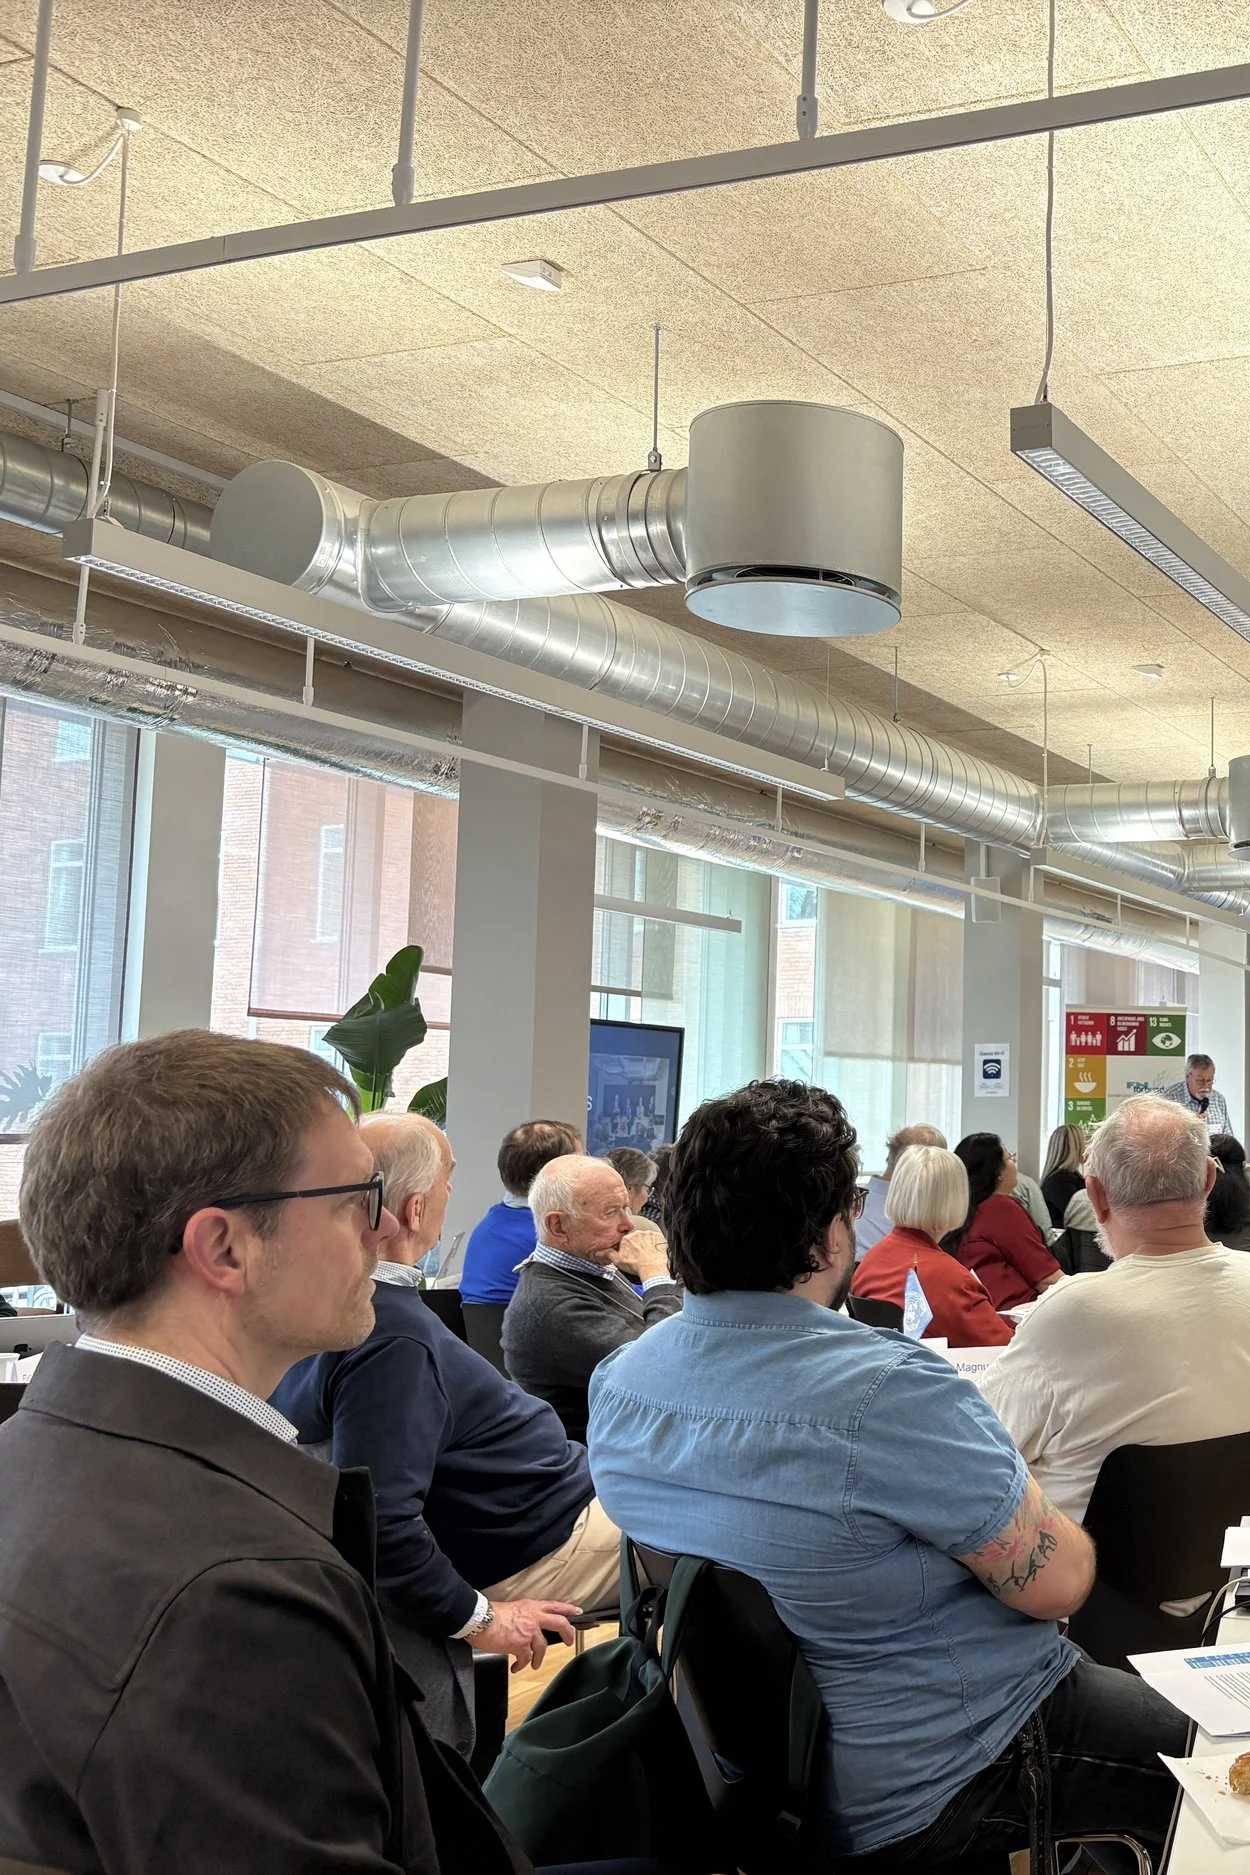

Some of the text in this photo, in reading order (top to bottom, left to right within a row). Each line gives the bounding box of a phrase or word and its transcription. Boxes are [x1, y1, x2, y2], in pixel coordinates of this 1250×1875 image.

[1070, 1015, 1074, 1025] 1
[1109, 1016, 1116, 1026] 8
[1149, 1016, 1158, 1027] 13
[1068, 1057, 1074, 1068] 2
[1067, 1101, 1074, 1111] 3
[957, 1363, 989, 1374] Magnu
